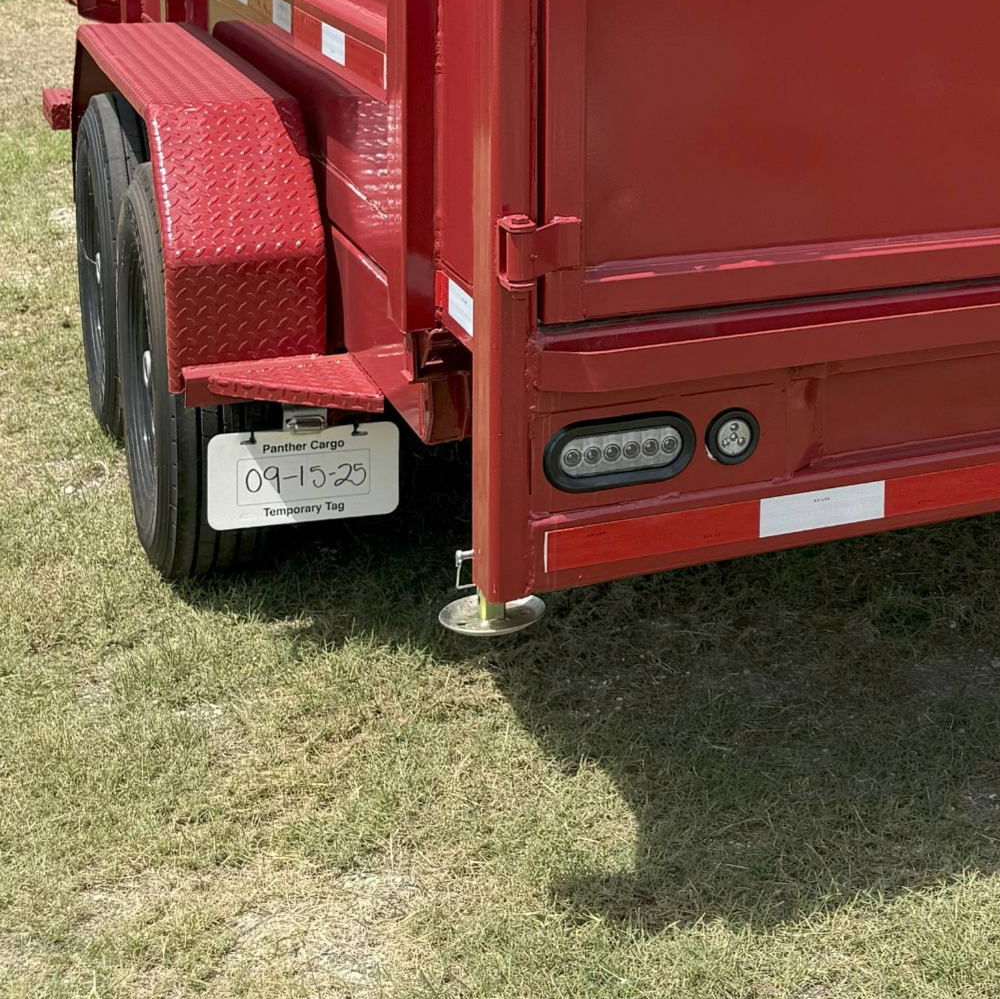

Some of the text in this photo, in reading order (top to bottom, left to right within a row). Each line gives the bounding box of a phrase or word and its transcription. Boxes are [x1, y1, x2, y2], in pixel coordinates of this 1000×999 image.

[262, 438, 345, 454] Panther Cargo
[245, 463, 367, 494] 09-15-25
[263, 501, 345, 517] Temporary Tag
